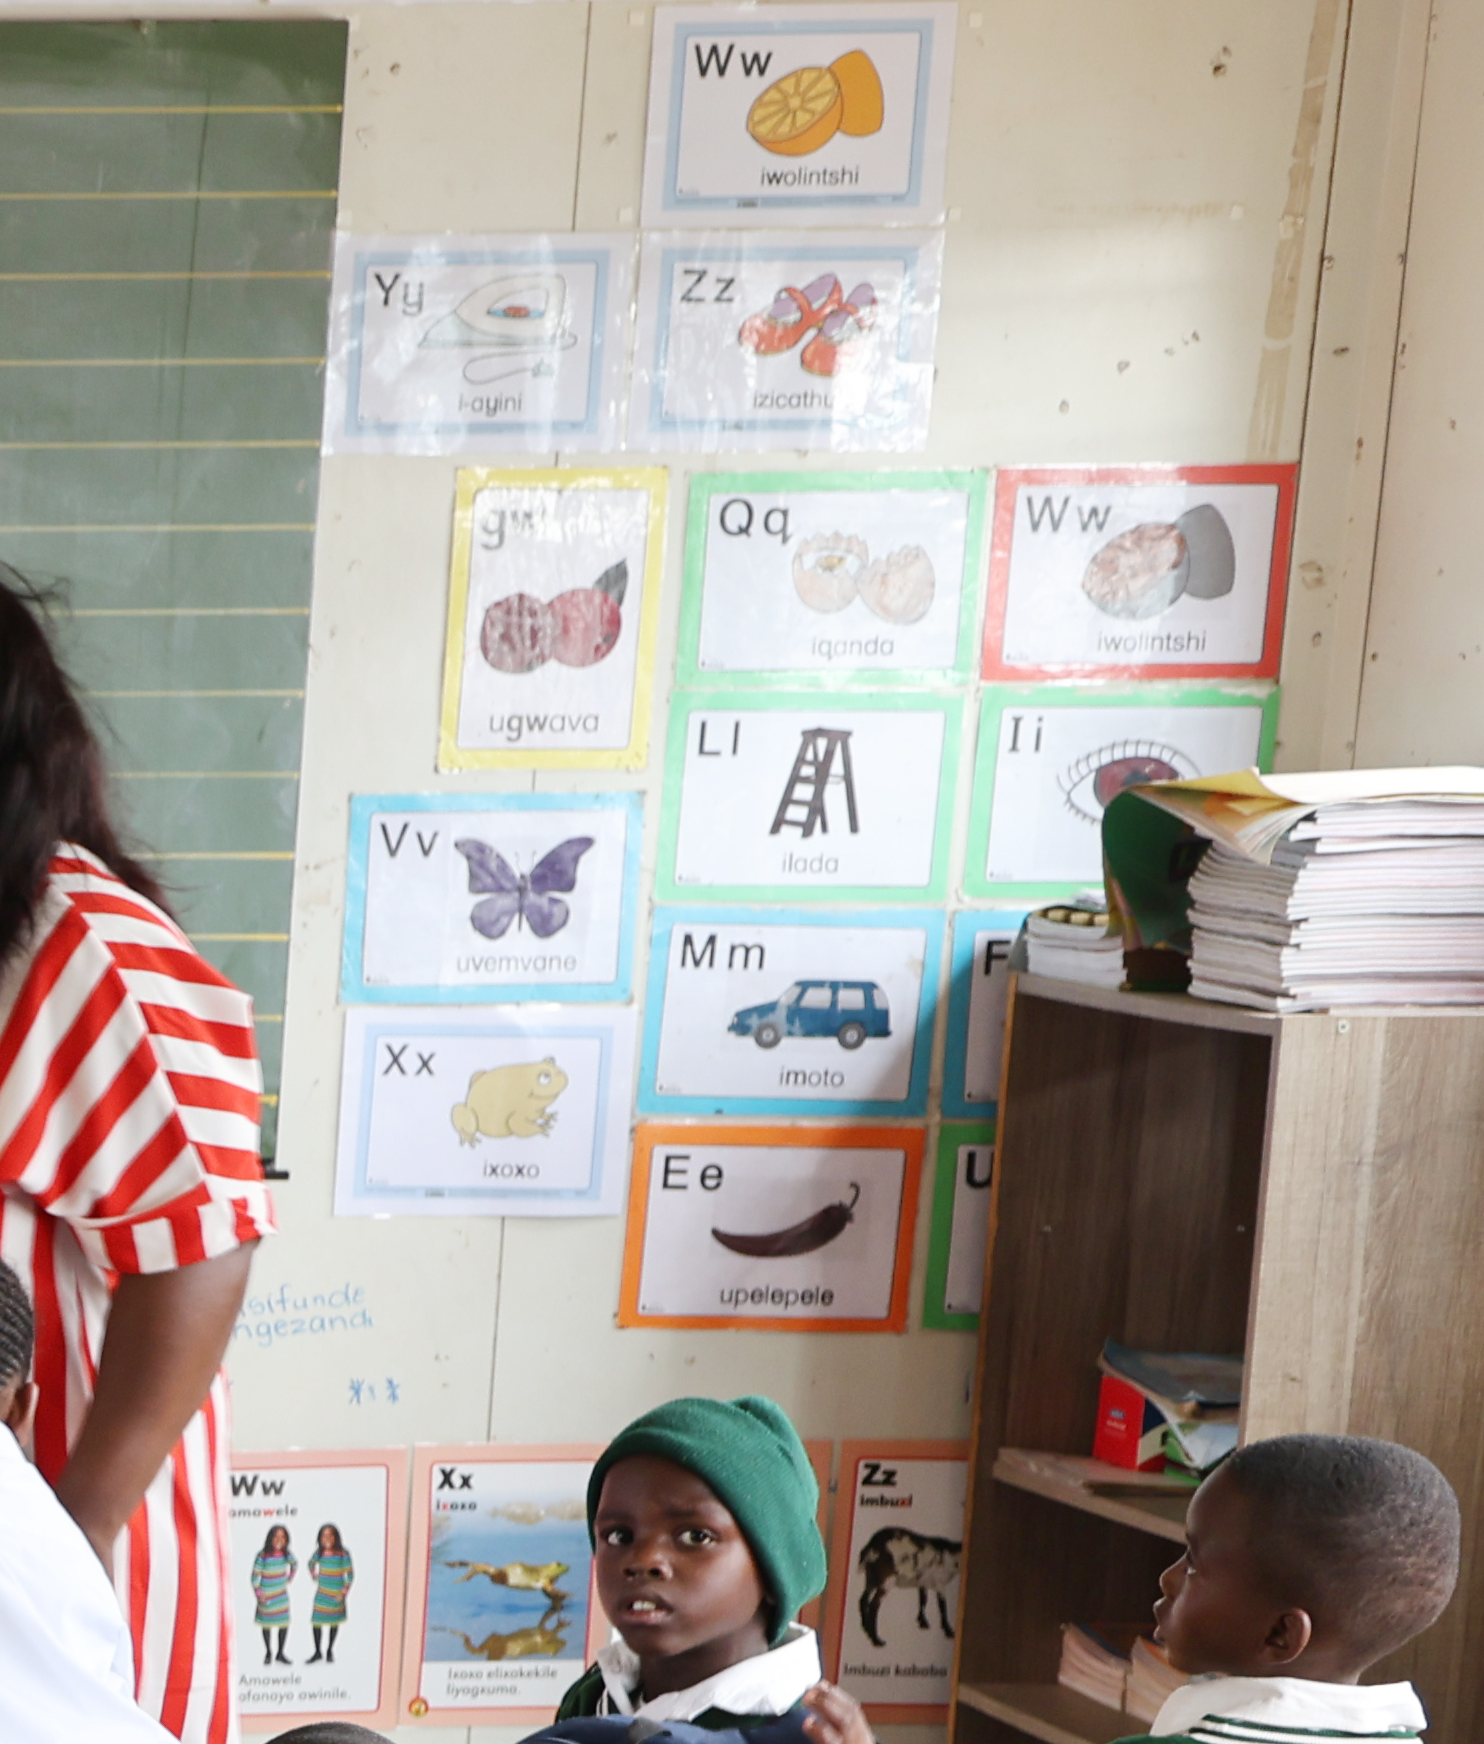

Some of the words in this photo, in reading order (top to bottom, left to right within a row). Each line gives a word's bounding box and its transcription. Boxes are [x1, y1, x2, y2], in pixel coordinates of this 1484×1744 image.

[761, 165, 859, 186] iwolintshi
[458, 392, 522, 416] i-ayini
[811, 631, 894, 662] iqanda
[1096, 629, 1207, 654] iwolintshi
[489, 713, 599, 742] ugwava
[782, 851, 840, 875] ilada
[456, 953, 577, 974] uvemvane
[779, 1066, 846, 1088] imoto
[483, 1159, 540, 1180] ixoxo
[720, 1285, 834, 1310] upelepele
[438, 1468, 473, 1490] Xx
[862, 1463, 897, 1486] Zz
[231, 1475, 284, 1497] Ww
[230, 1504, 297, 1518] amawele
[436, 1499, 477, 1511] ixoxo
[860, 1494, 913, 1507] imbuzi
[238, 1674, 302, 1686] Amawele
